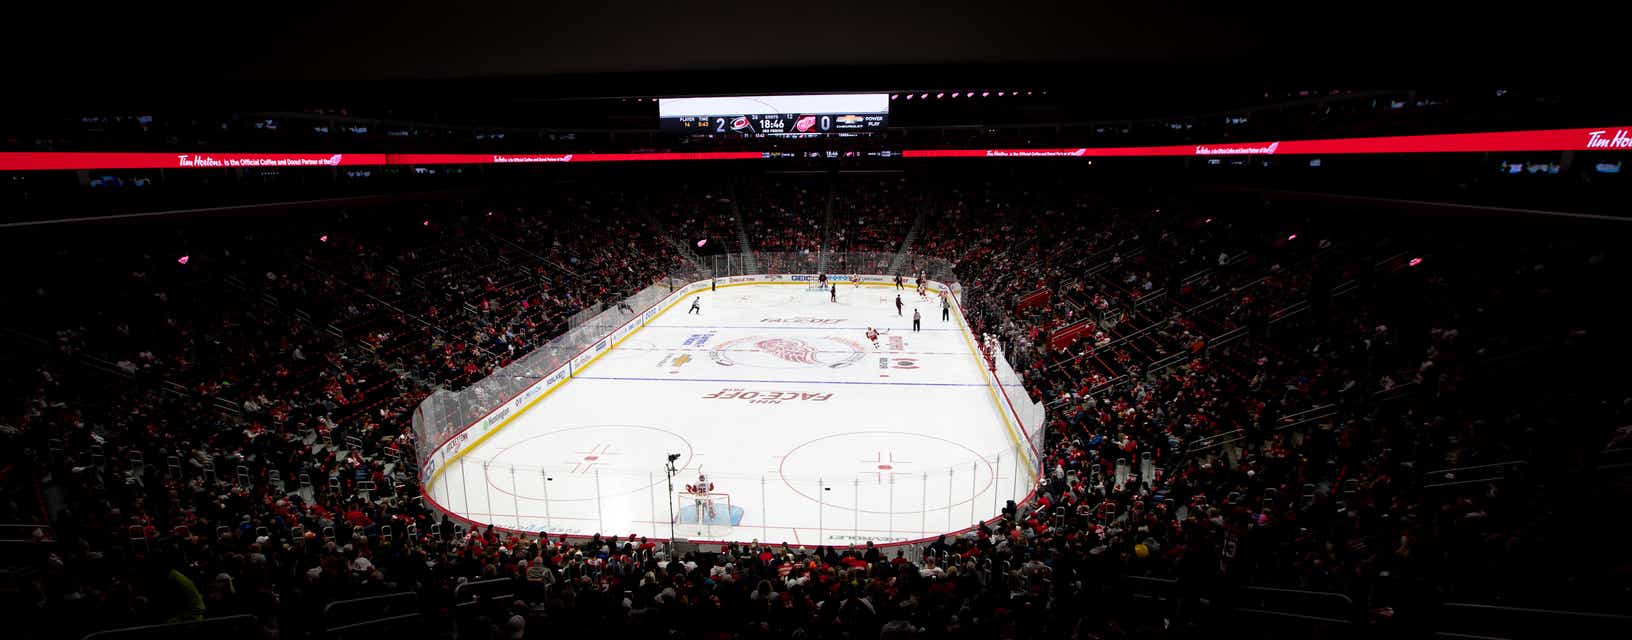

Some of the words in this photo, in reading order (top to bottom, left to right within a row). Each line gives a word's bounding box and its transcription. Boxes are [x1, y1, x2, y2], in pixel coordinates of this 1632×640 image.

[716, 117, 726, 133] 2
[759, 119, 785, 129] 18:46
[820, 115, 831, 131] 0
[1586, 130, 1610, 148] Tim
[177, 154, 194, 167] Tim
[194, 154, 222, 167] Hortons
